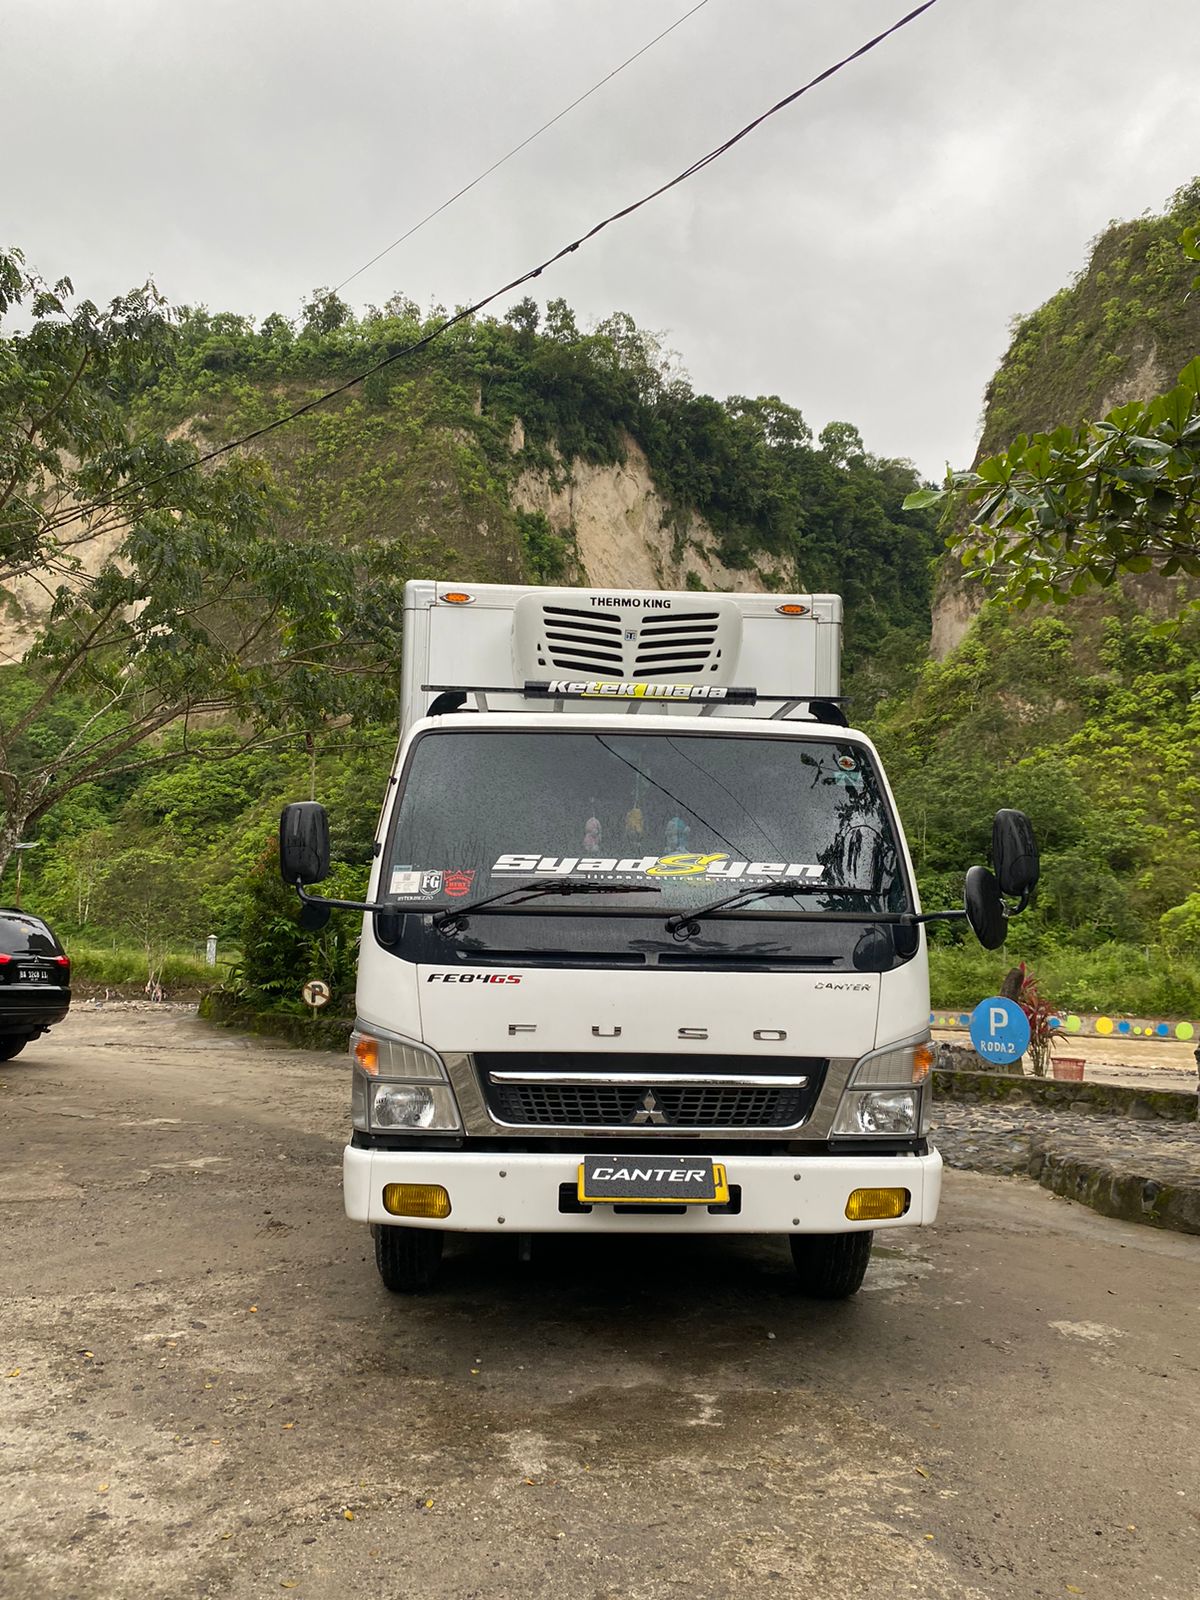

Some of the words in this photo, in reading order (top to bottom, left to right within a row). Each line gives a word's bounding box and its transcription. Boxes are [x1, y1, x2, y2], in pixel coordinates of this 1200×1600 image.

[590, 597, 641, 607] THERMO
[643, 599, 671, 609] KING
[548, 681, 636, 697] Ketek
[422, 875, 440, 889] FG
[427, 973, 523, 984] FE84GS
[814, 982, 872, 991] CANTER
[990, 1007, 1009, 1037] P
[508, 1023, 788, 1042] FUSO
[980, 1040, 1007, 1053] RODA
[1007, 1042, 1016, 1054] 2
[591, 1167, 707, 1182] CANTER
